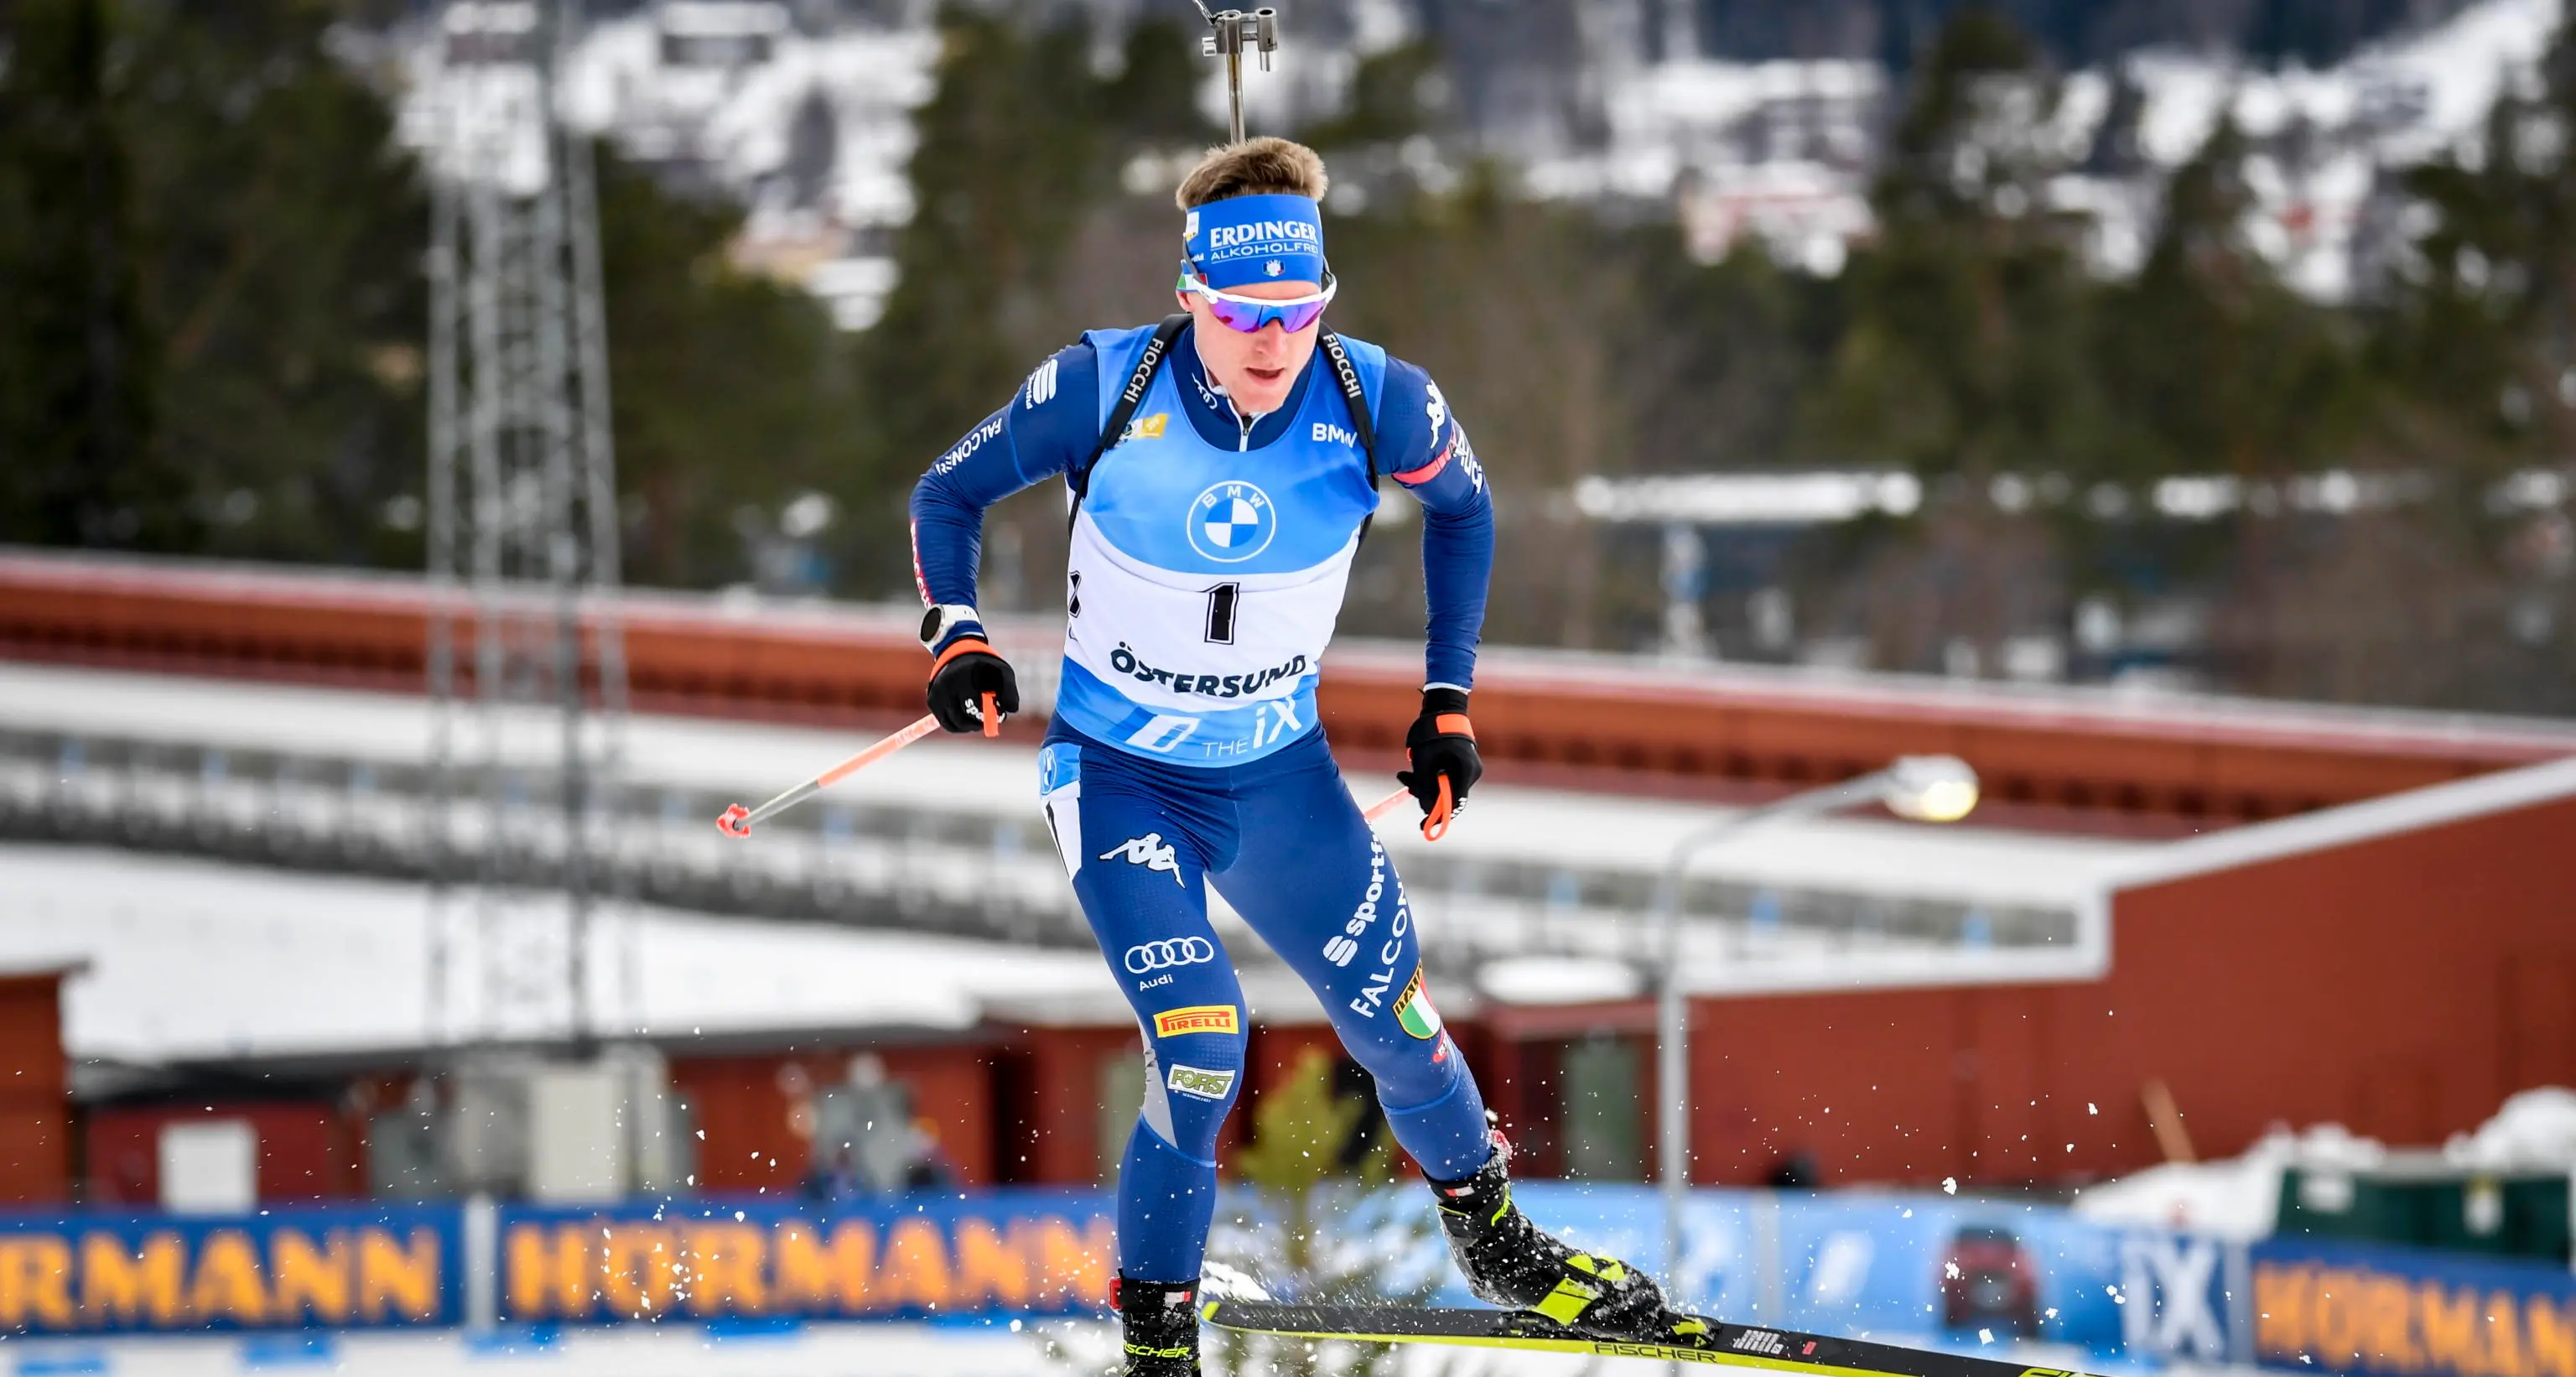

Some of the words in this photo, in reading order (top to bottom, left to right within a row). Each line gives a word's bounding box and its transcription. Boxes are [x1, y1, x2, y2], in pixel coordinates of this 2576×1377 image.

[1210, 221, 1318, 248] ERDINGER
[1211, 242, 1319, 261] ALKOHOLFREI
[1123, 338, 1164, 403] FIOCCHI
[1322, 333, 1362, 398] FIOCCHI
[1311, 422, 1358, 449] BMW
[1202, 486, 1265, 508] BMW
[1198, 581, 1240, 645] 1
[1110, 642, 1306, 699] ÖSTERSUND
[1202, 736, 1249, 758] THE
[1252, 696, 1303, 749] iX
[1140, 974, 1174, 992] Audi
[1161, 1011, 1230, 1032] PIRELLI
[1171, 1068, 1233, 1095] FORST
[1594, 1343, 1718, 1364] FISCHER
